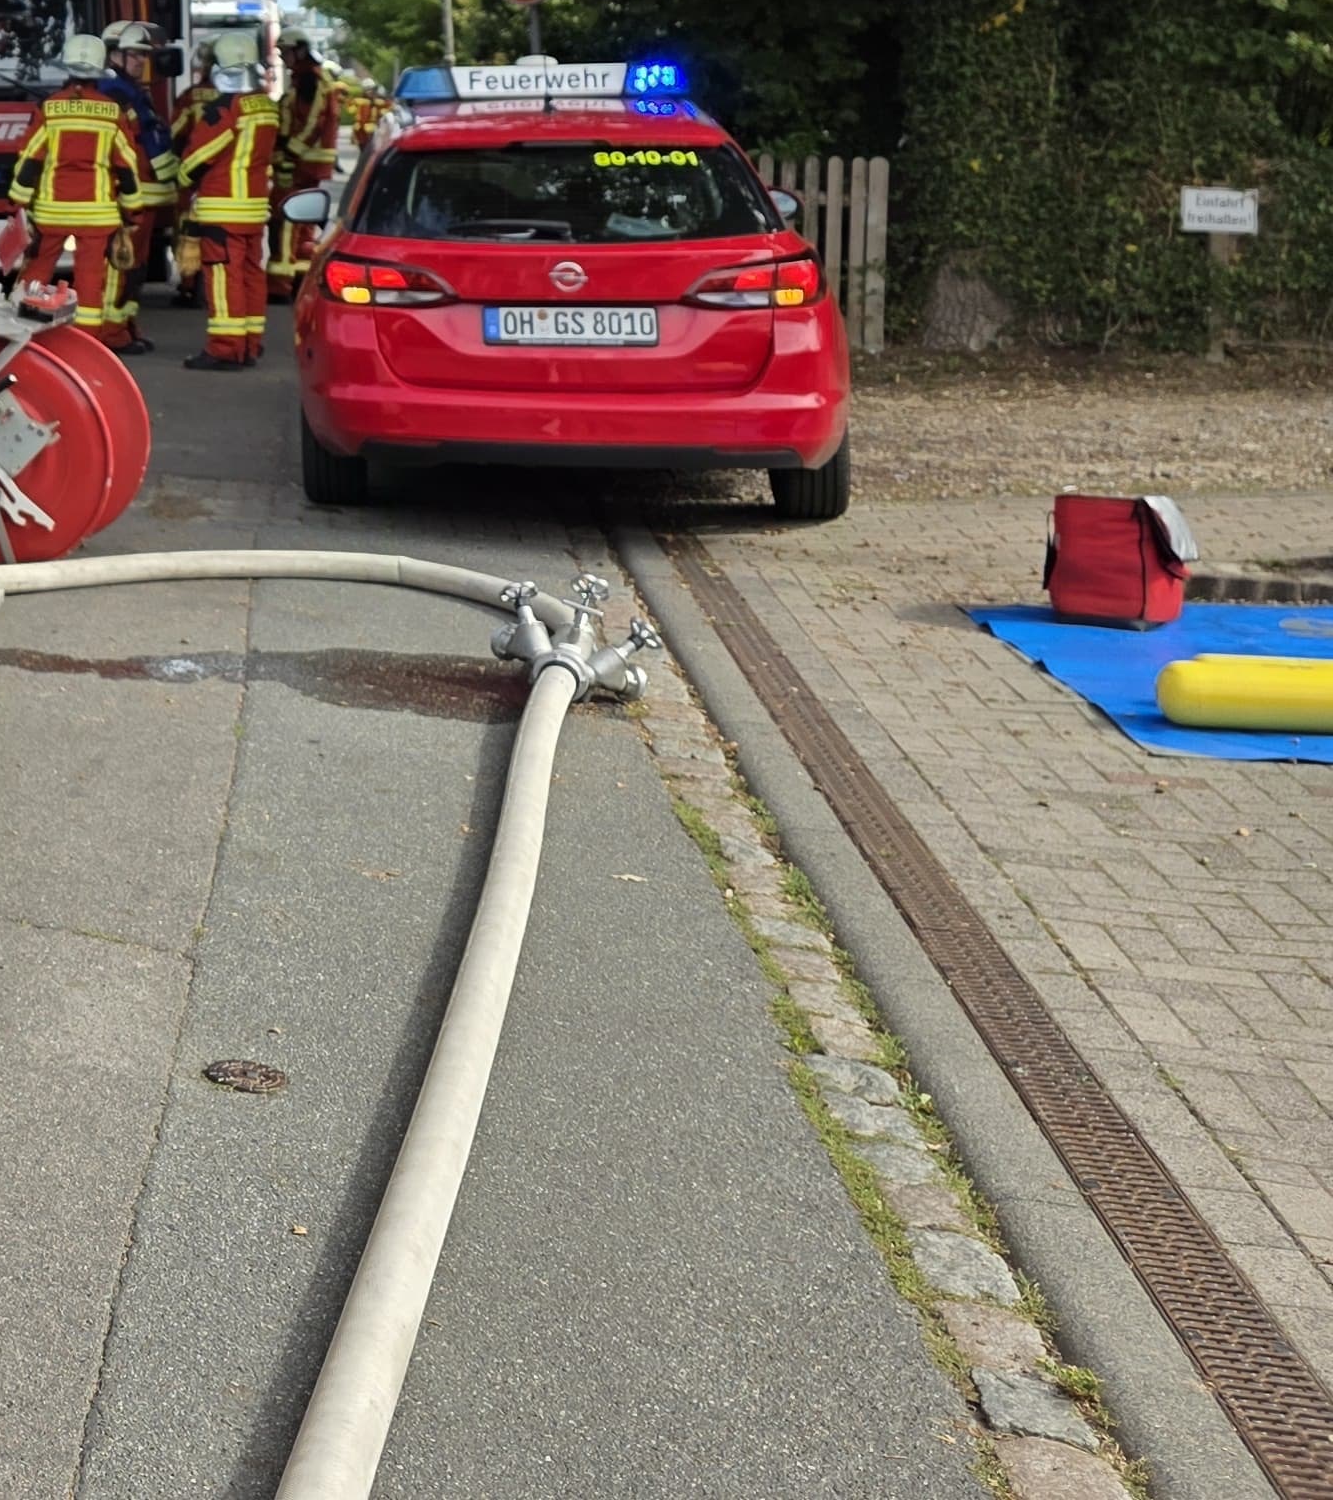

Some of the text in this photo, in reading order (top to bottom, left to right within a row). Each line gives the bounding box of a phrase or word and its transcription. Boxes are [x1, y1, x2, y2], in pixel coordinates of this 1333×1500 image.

[468, 70, 611, 91] Feuerwehr
[46, 100, 117, 117] FEUERWEHR
[1195, 192, 1245, 208] Einfahrt
[503, 310, 655, 336] OH GS 8010
